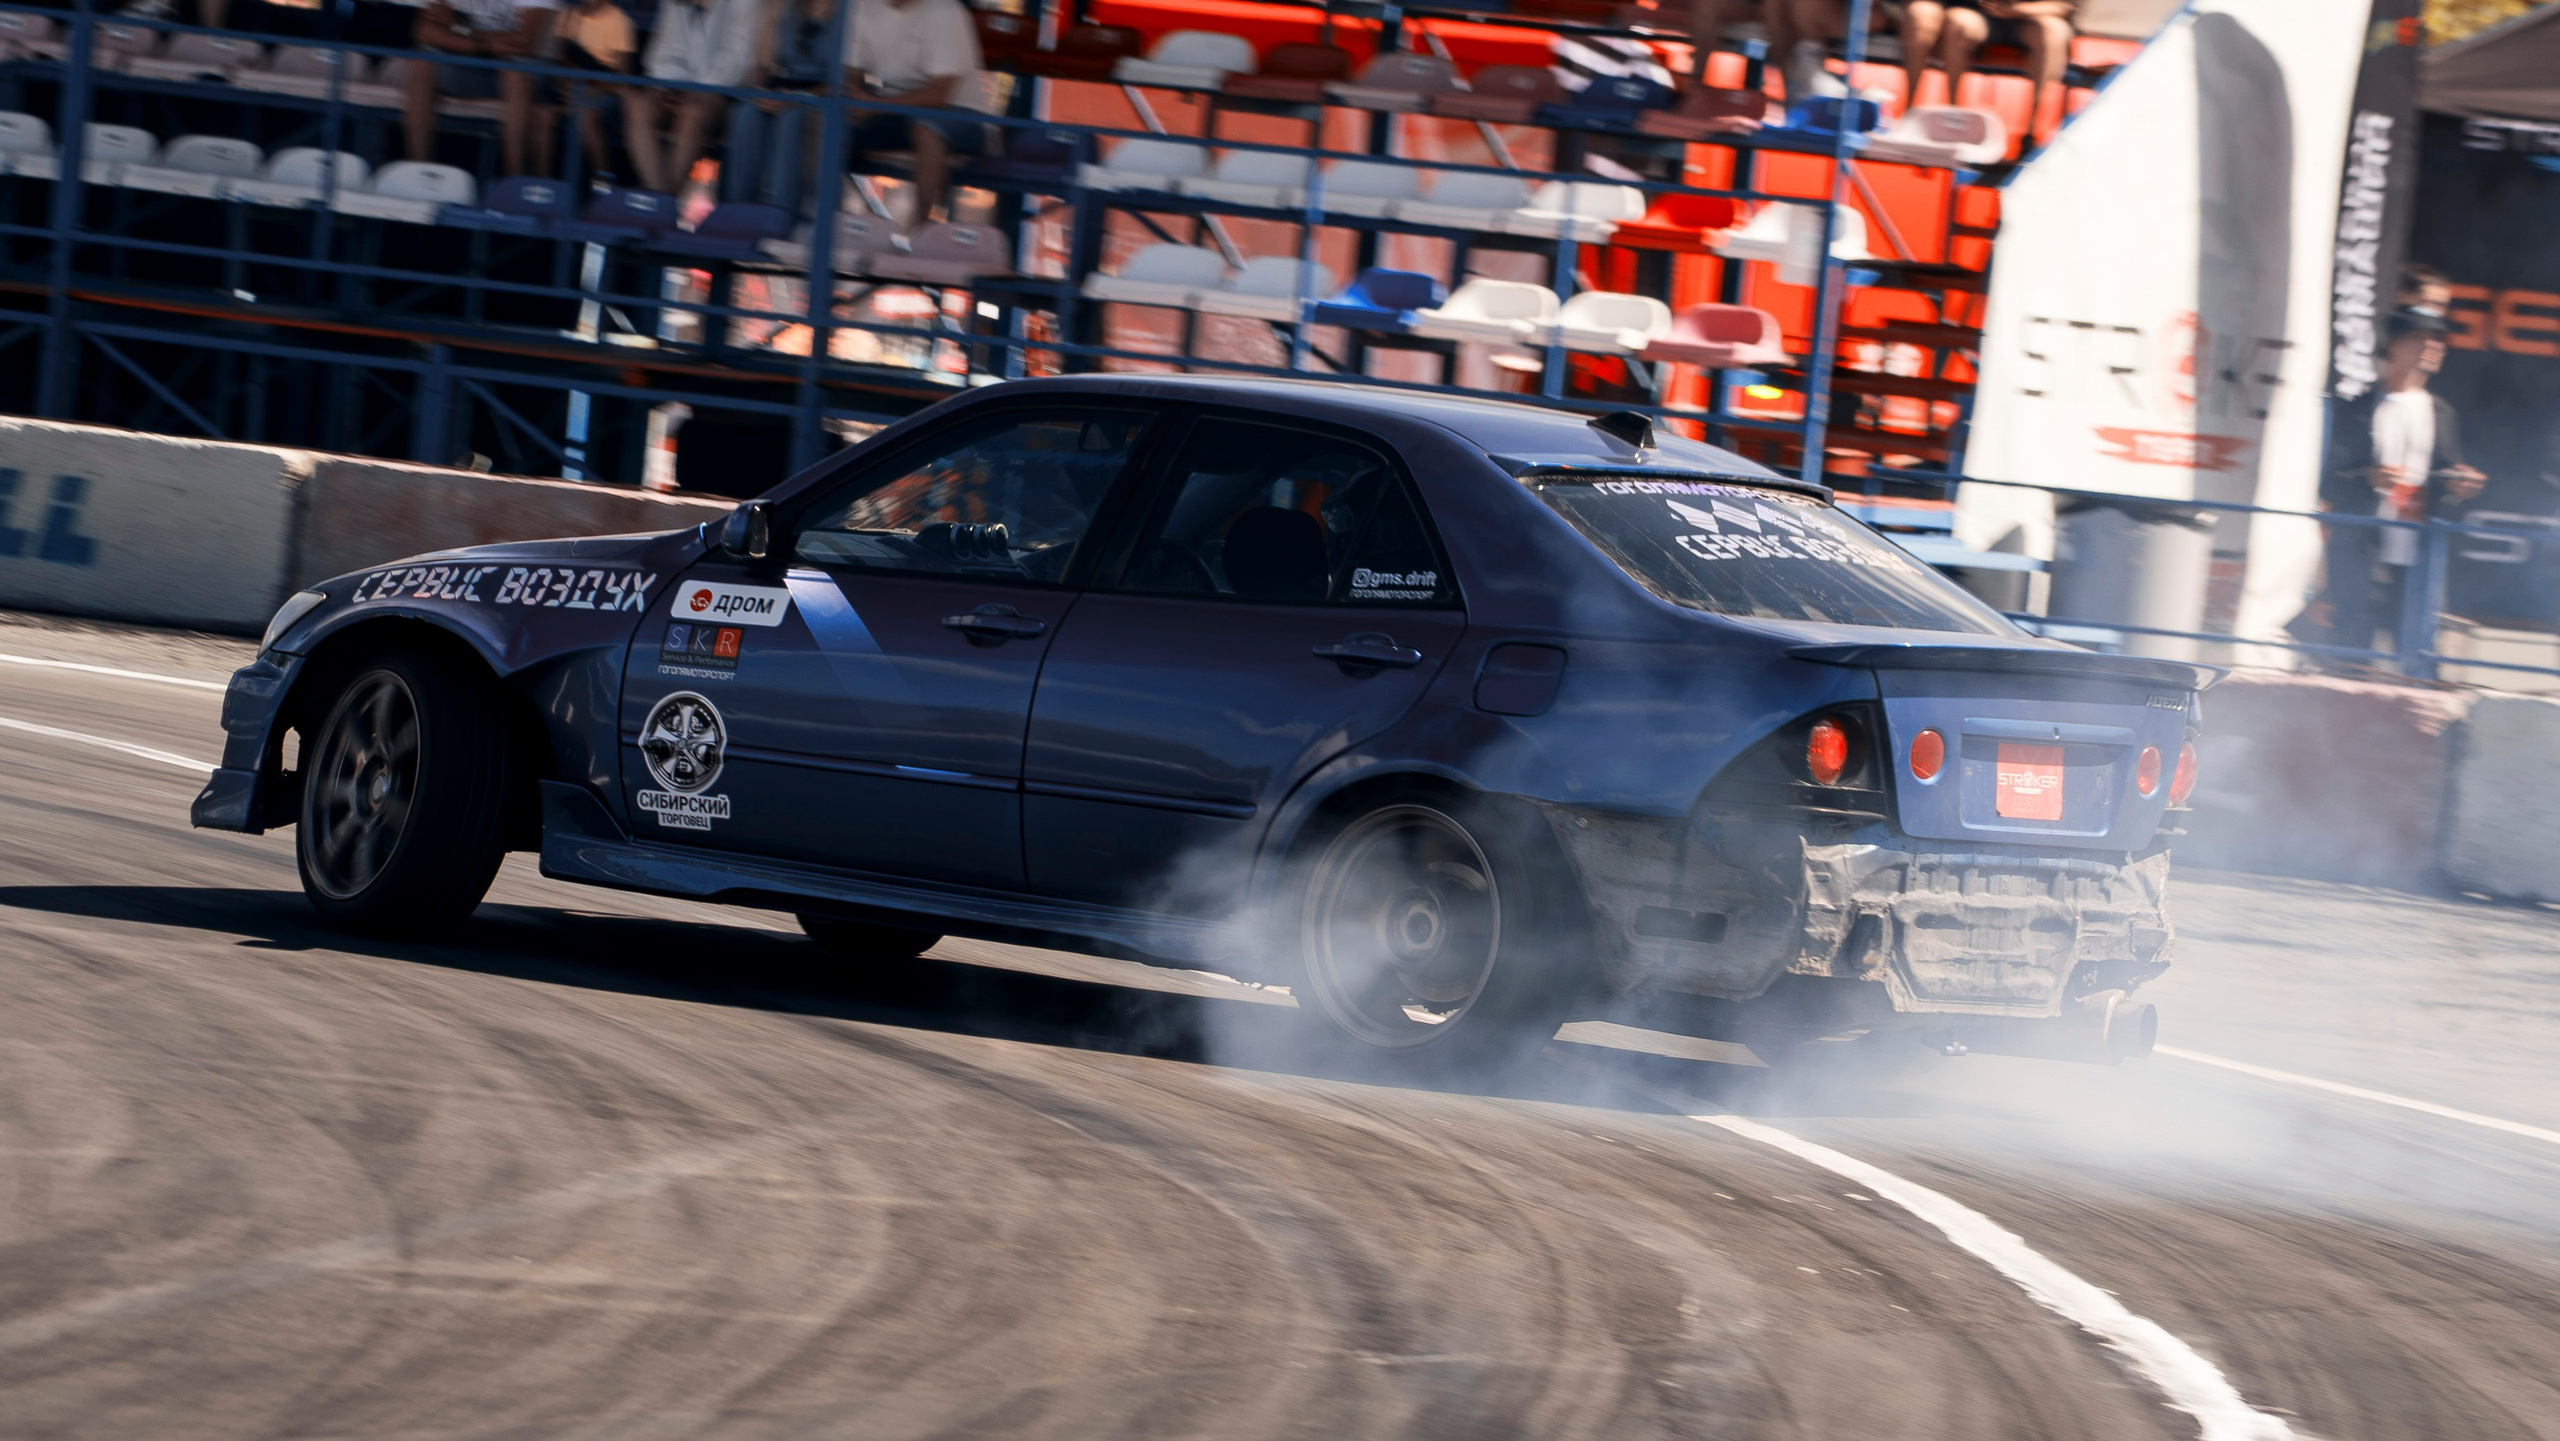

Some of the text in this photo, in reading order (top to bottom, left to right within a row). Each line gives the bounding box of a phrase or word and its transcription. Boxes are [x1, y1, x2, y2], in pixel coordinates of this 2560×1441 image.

[352, 566, 658, 612] СЕРВИС ВОЗДУХ
[713, 594, 775, 617] дром
[640, 791, 728, 816] СИБИРСКИЙ
[661, 812, 709, 828] ТОРГОВЕЦ
